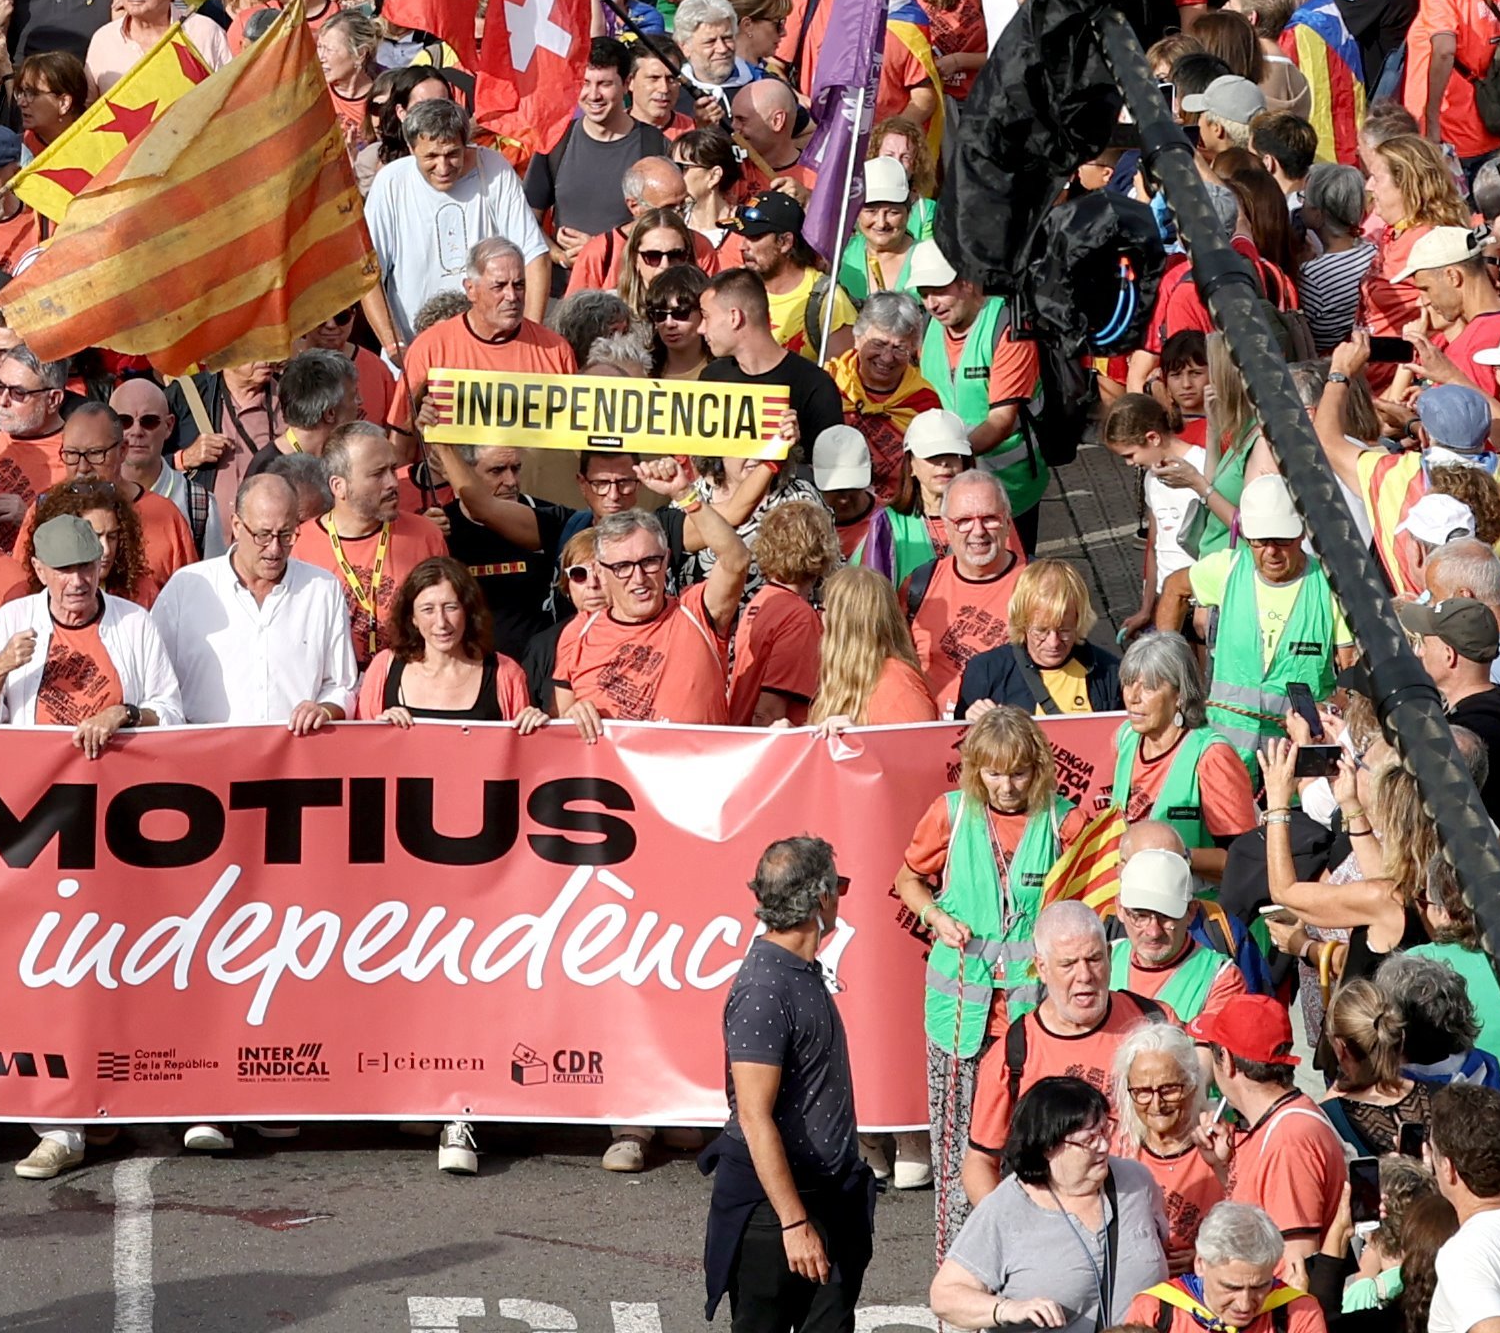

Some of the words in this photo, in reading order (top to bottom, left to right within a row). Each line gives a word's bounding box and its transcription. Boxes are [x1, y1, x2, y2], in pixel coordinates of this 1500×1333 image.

[456, 379, 758, 441] INDEPENDÈNCIA
[470, 561, 527, 577] TALUNYA
[17, 863, 855, 1026] independènc
[133, 1048, 176, 1059] Consell
[237, 1046, 296, 1061] INTER
[133, 1060, 146, 1071] de
[150, 1060, 161, 1071] la
[163, 1059, 220, 1073] República
[237, 1061, 330, 1077] SINDICAL
[552, 1049, 604, 1074] CDR
[133, 1070, 183, 1082] Catalana
[552, 1074, 604, 1084] CATALUNYA
